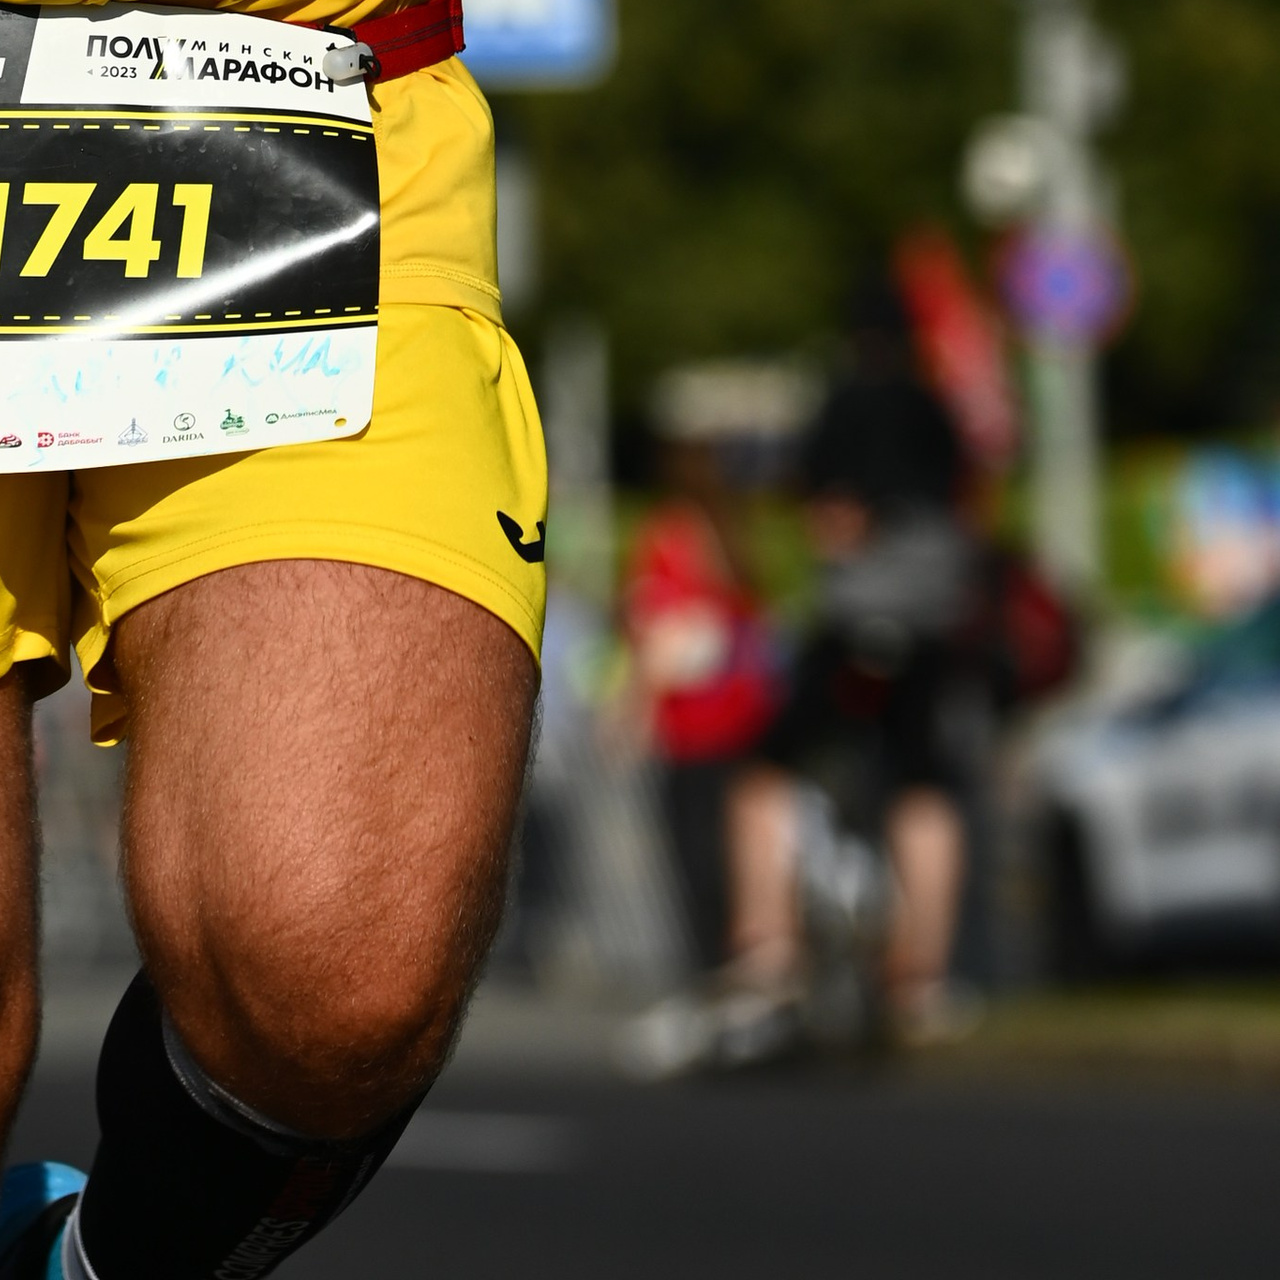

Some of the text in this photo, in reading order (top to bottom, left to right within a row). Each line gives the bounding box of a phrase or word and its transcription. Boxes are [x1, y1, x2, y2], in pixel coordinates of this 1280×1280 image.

[191, 40, 313, 66] МИНСКИ
[100, 66, 138, 79] 2023
[162, 432, 205, 444] DARIDA
